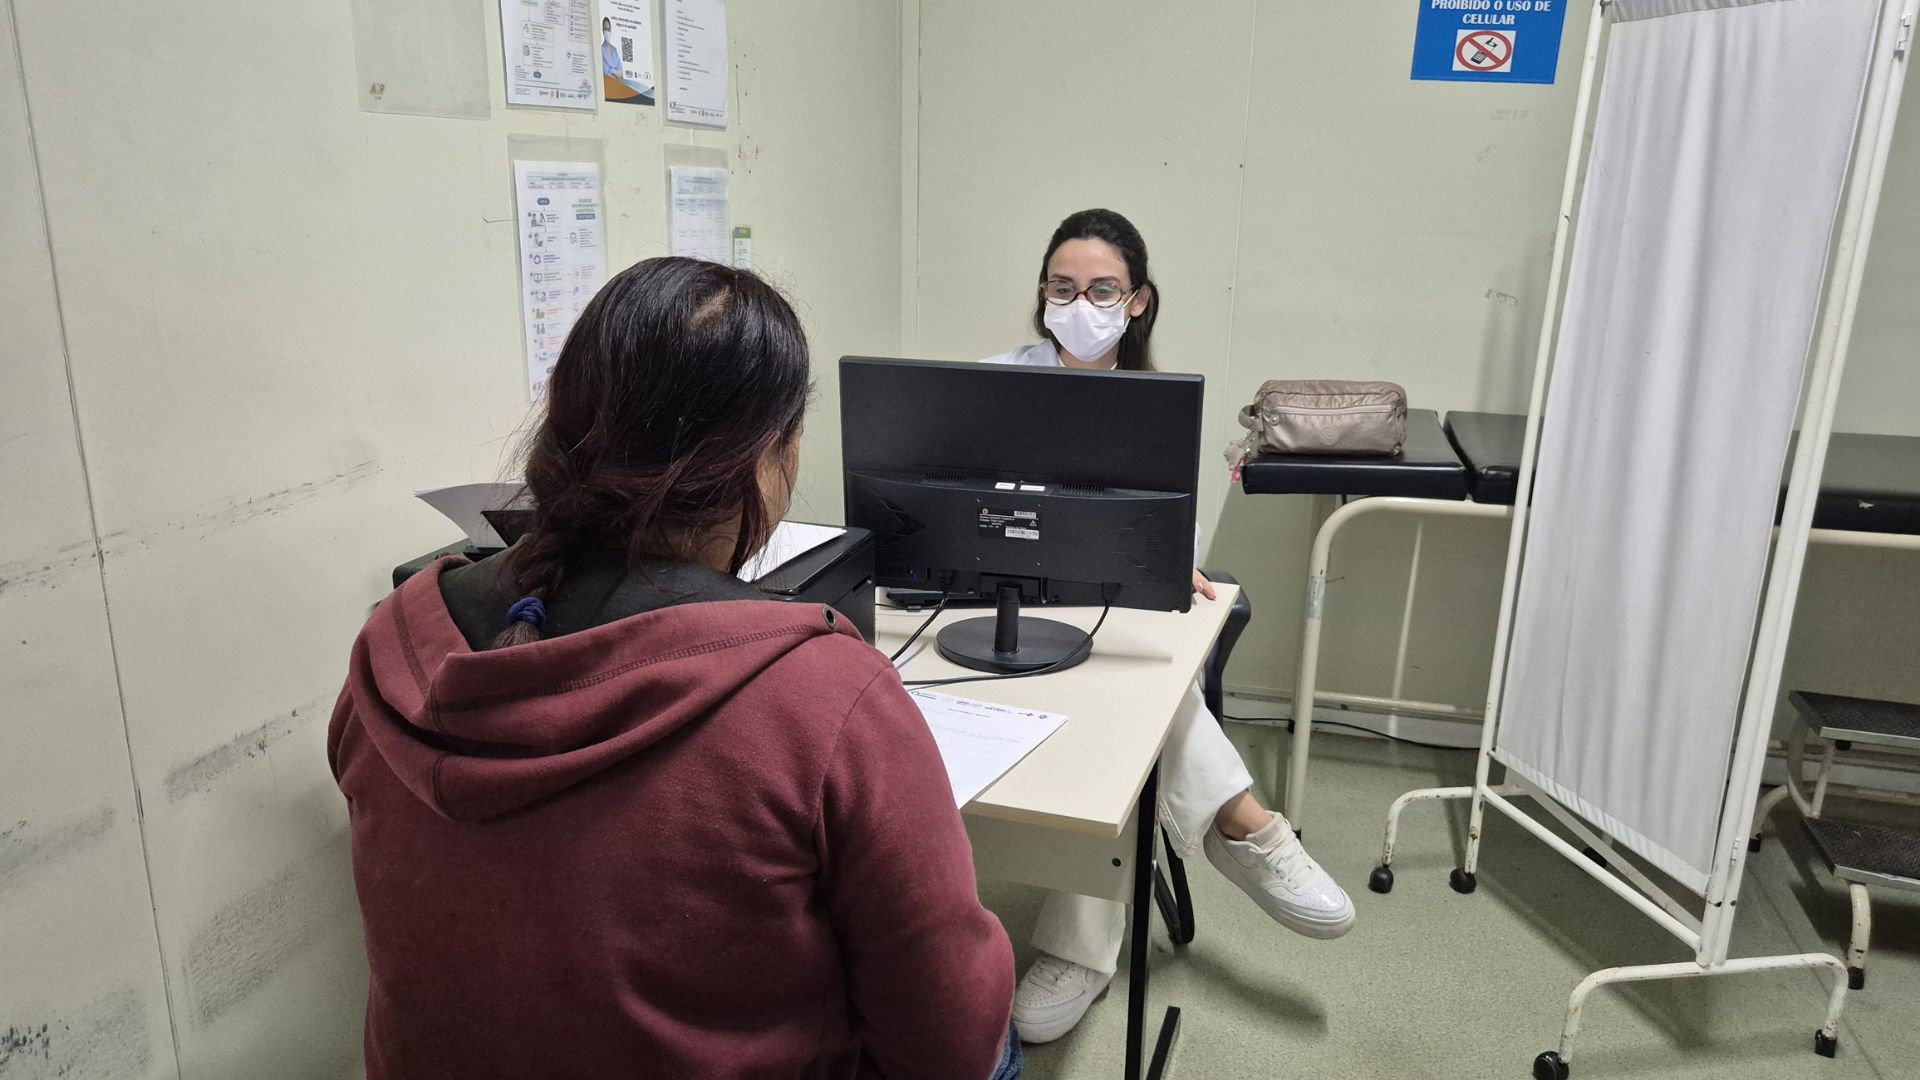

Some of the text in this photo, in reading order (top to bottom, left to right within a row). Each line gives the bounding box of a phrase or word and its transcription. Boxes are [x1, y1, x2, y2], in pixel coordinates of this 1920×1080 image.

[1431, 0, 1552, 12] PROIBIDO O USO DE
[1462, 13, 1515, 25] CELULAR
